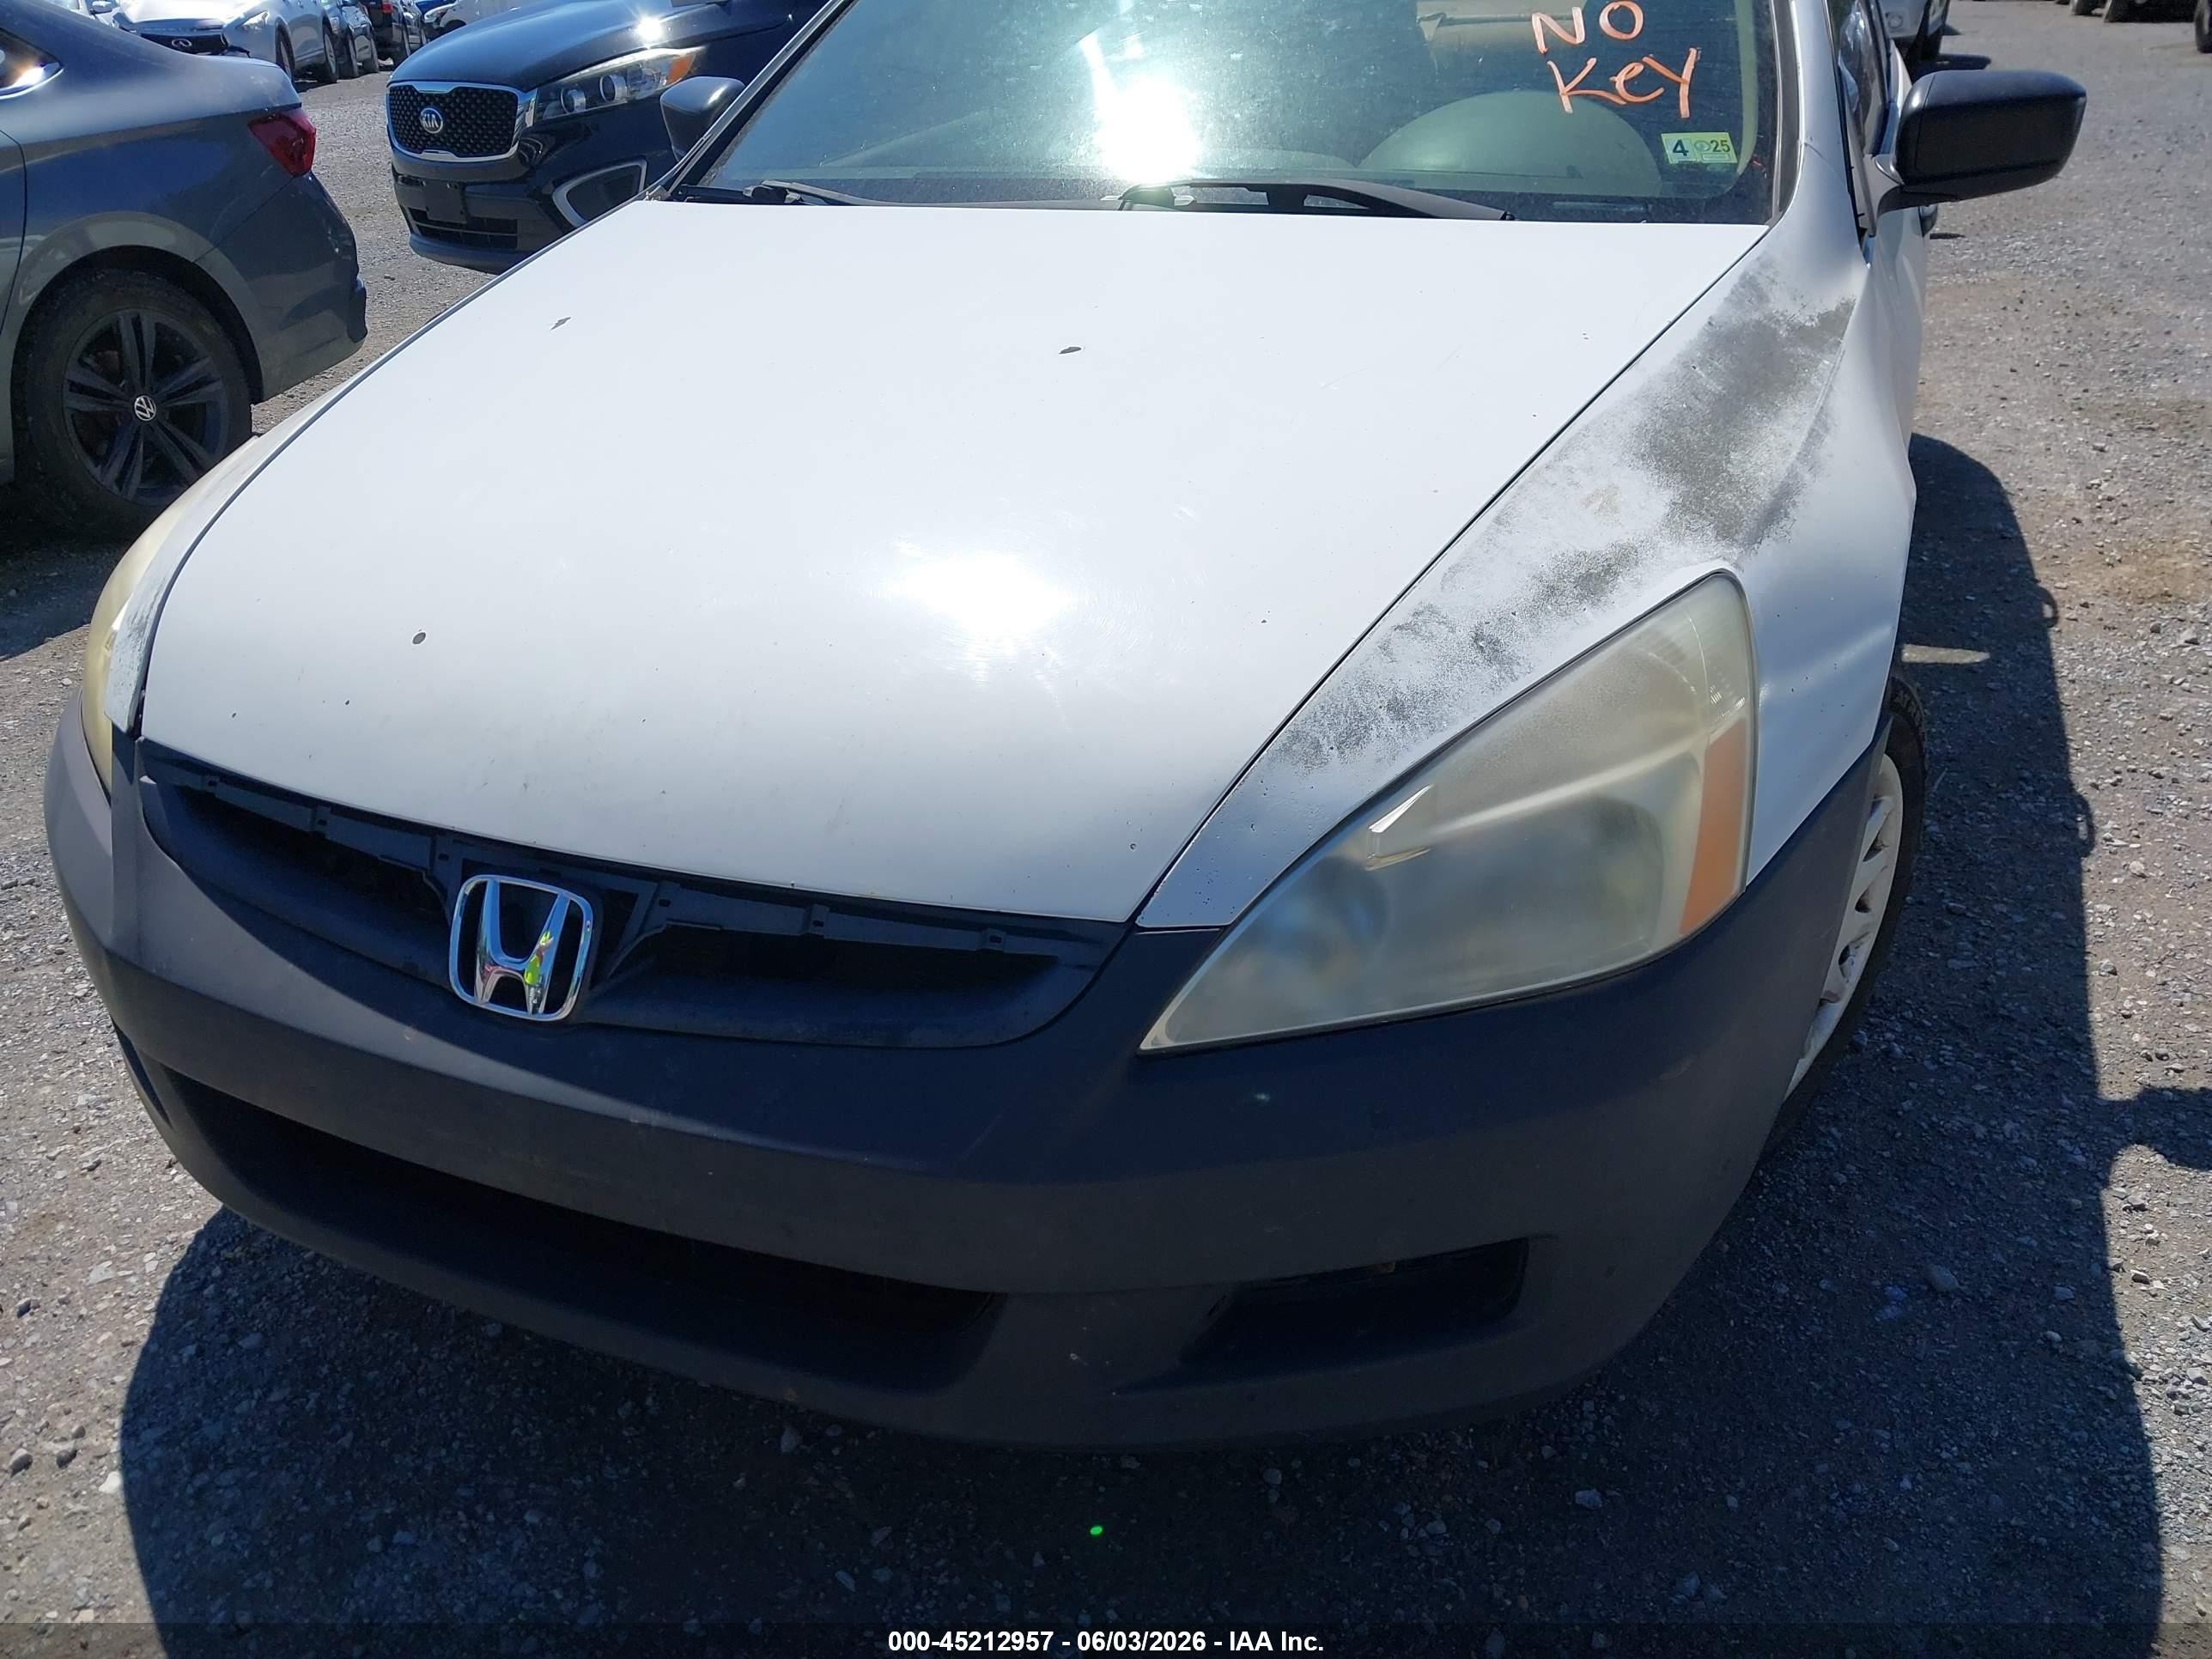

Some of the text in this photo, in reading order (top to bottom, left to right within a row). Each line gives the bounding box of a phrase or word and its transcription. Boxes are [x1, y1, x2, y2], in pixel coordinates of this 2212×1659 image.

[1531, 0, 1644, 53] NO
[422, 112, 440, 128] KIA
[1672, 138, 1731, 156] 4 25
